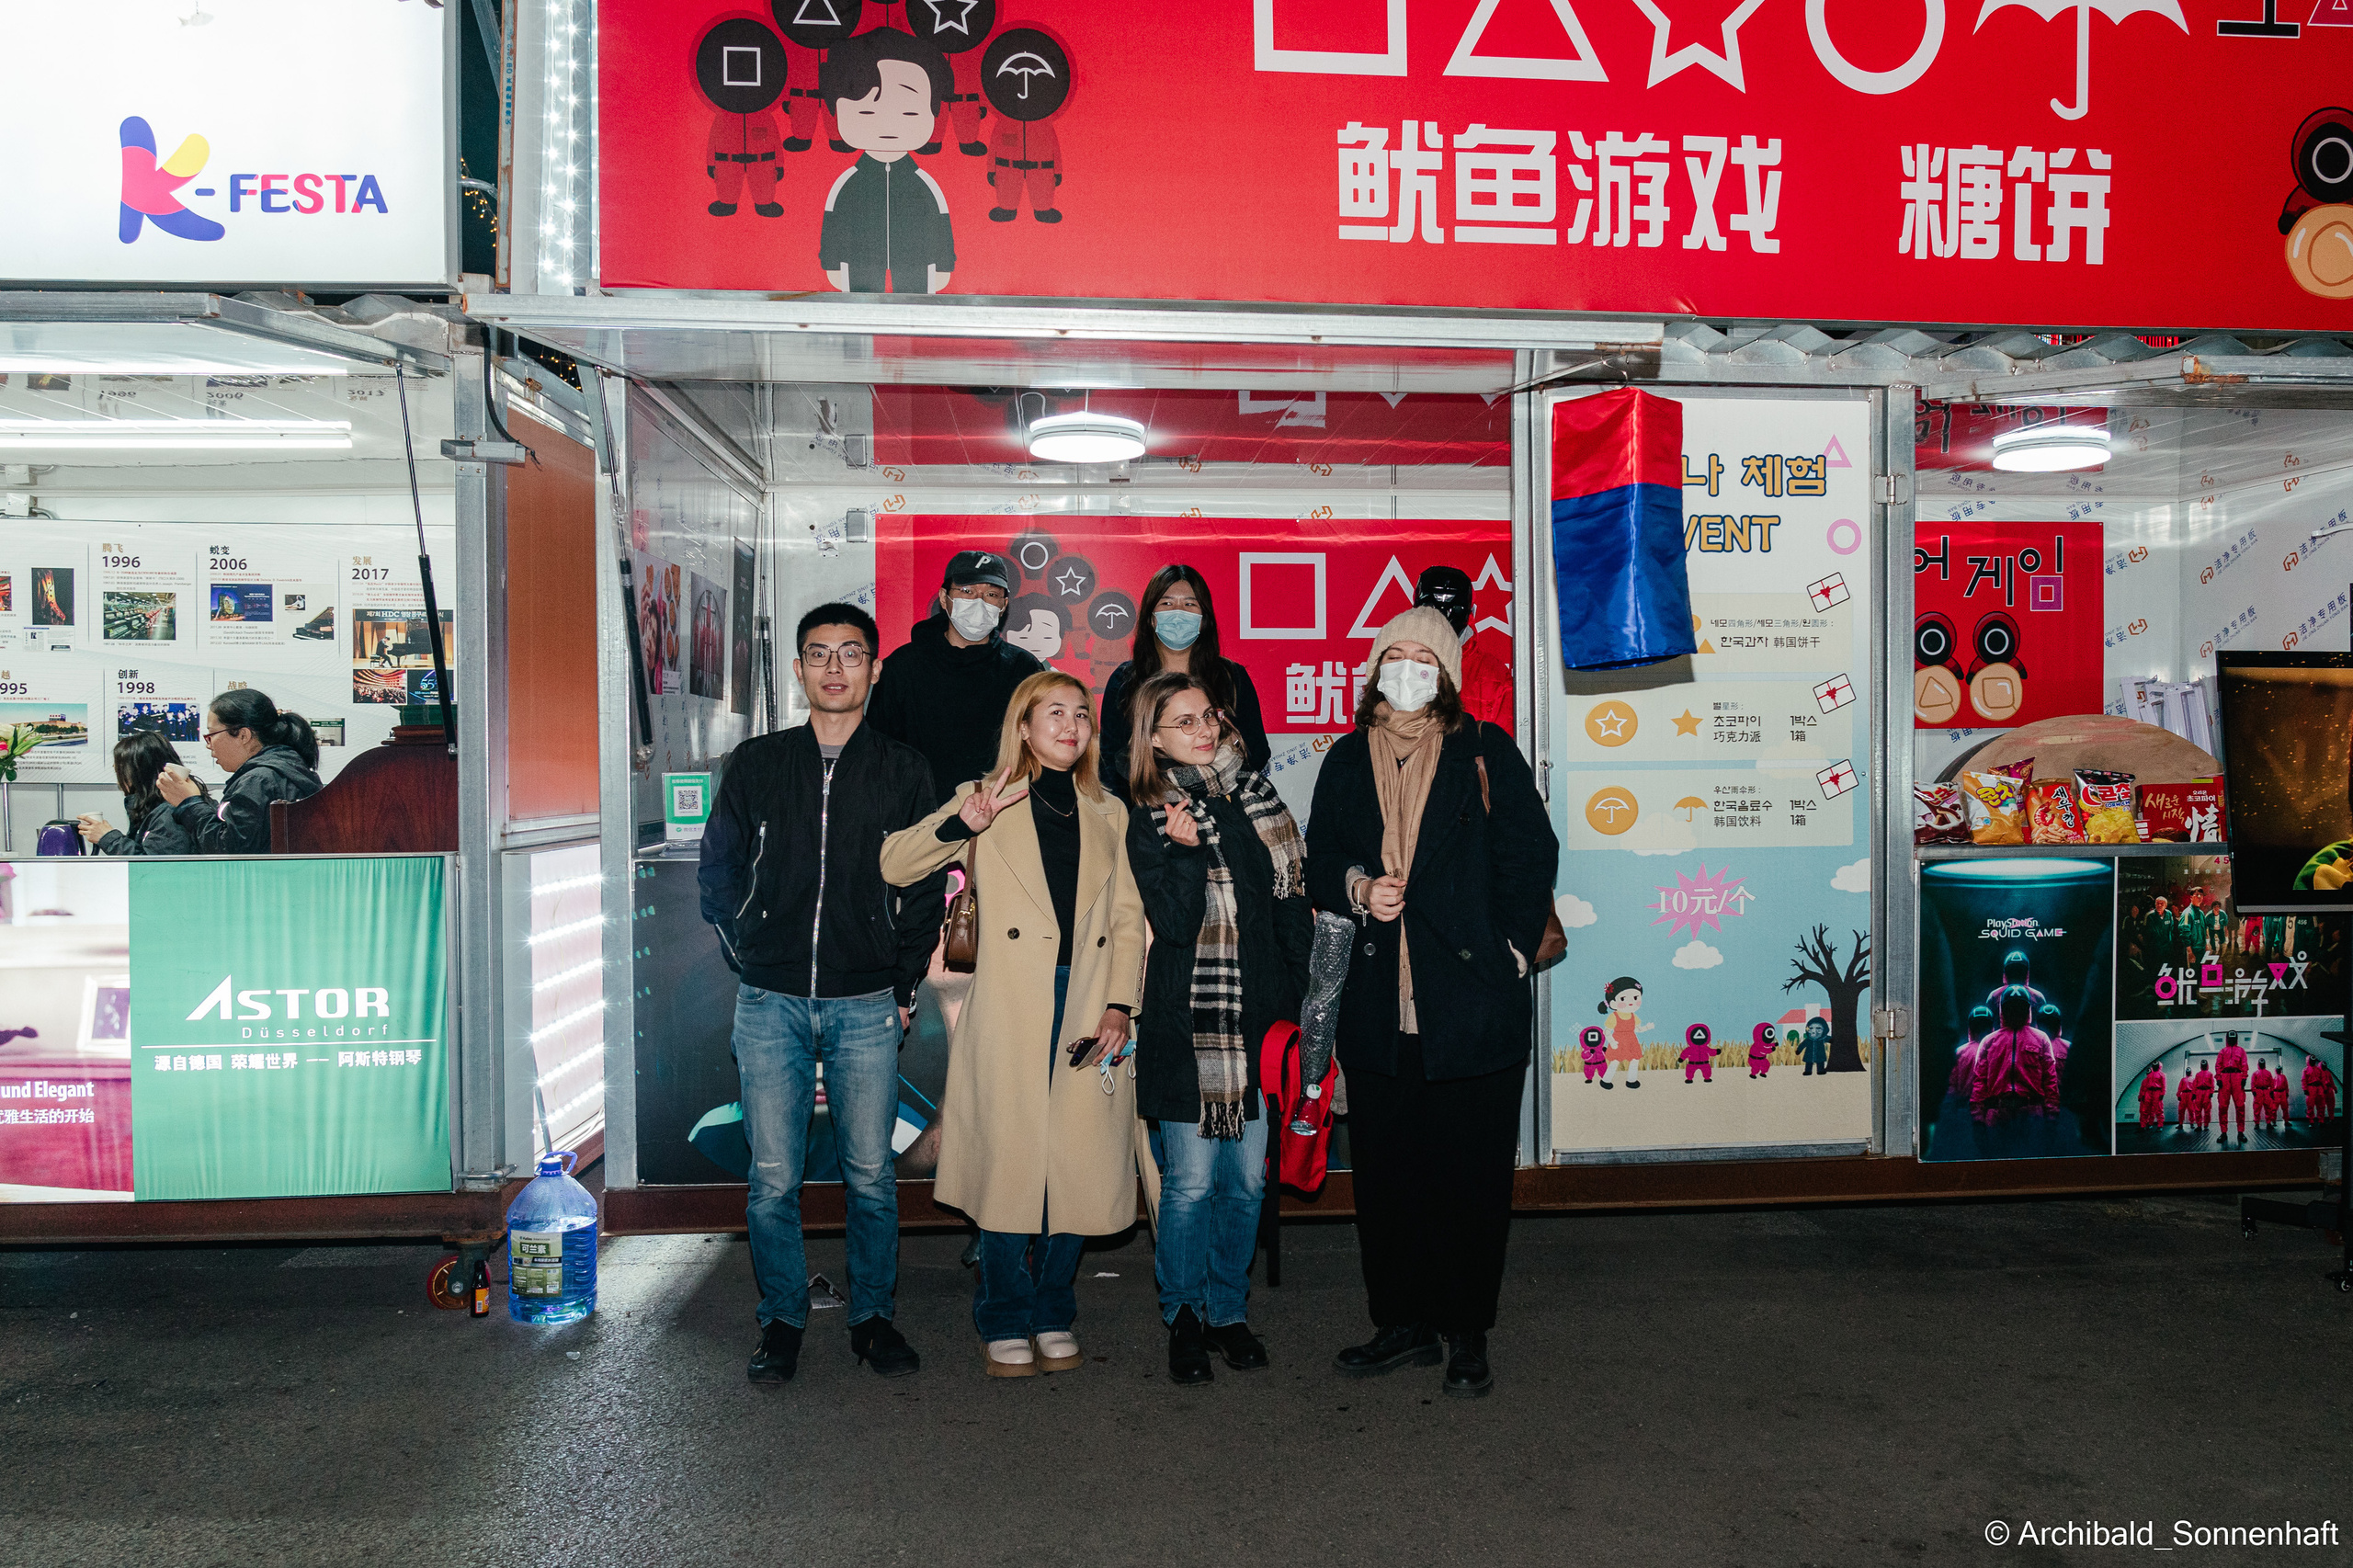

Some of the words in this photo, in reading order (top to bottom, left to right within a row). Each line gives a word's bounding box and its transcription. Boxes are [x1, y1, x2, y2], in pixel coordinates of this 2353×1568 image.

[119, 116, 389, 244] K-FESTA
[1337, 119, 1782, 255] 鱿鱼游戏
[1898, 144, 2112, 266] 糖饼
[1741, 453, 1826, 497] 체험
[102, 542, 124, 553] 腾飞
[210, 545, 231, 556] 蜕变
[2213, 528, 2256, 571] 洁净专用板
[102, 555, 141, 568] 1996
[210, 558, 247, 571] 2006
[352, 555, 373, 566] 发展
[975, 555, 992, 569] P
[352, 568, 390, 580] 2017
[1963, 535, 2064, 612] 게임
[2298, 592, 2347, 637] 洁净专用板
[2213, 605, 2256, 645] 洁净专用板
[1721, 636, 1768, 648] 한국과자
[1773, 636, 1821, 649] 韩国饼干
[118, 669, 139, 679] 创新
[117, 682, 155, 694] 1998
[1713, 715, 1761, 727] 초코파이
[1790, 715, 1817, 726] 1박스
[1713, 730, 1761, 743] 巧克力派
[1790, 730, 1806, 742] 1箱
[1713, 800, 1772, 812] 한국음료수
[1790, 800, 1817, 811] 1박스
[2052, 786, 2075, 828] 새우깡
[2144, 793, 2180, 811] 새로운
[1713, 815, 1761, 827] 韩国饮料
[1790, 814, 1806, 826] 1箱
[2163, 807, 2185, 824] 시작
[1657, 885, 1756, 916] 10元/个
[1978, 926, 2021, 940] SQUID
[2025, 927, 2067, 941] GAME
[2154, 950, 2309, 1017] 鱿鱼游戏
[185, 973, 390, 1021] ASTOR
[242, 1024, 388, 1039] Düsseldorf
[153, 1053, 222, 1072] 源自德国
[231, 1051, 299, 1070] 荣耀世界
[337, 1049, 423, 1068] 阿斯特钢琴
[1, 1081, 31, 1098] und
[34, 1081, 95, 1102] Elegant
